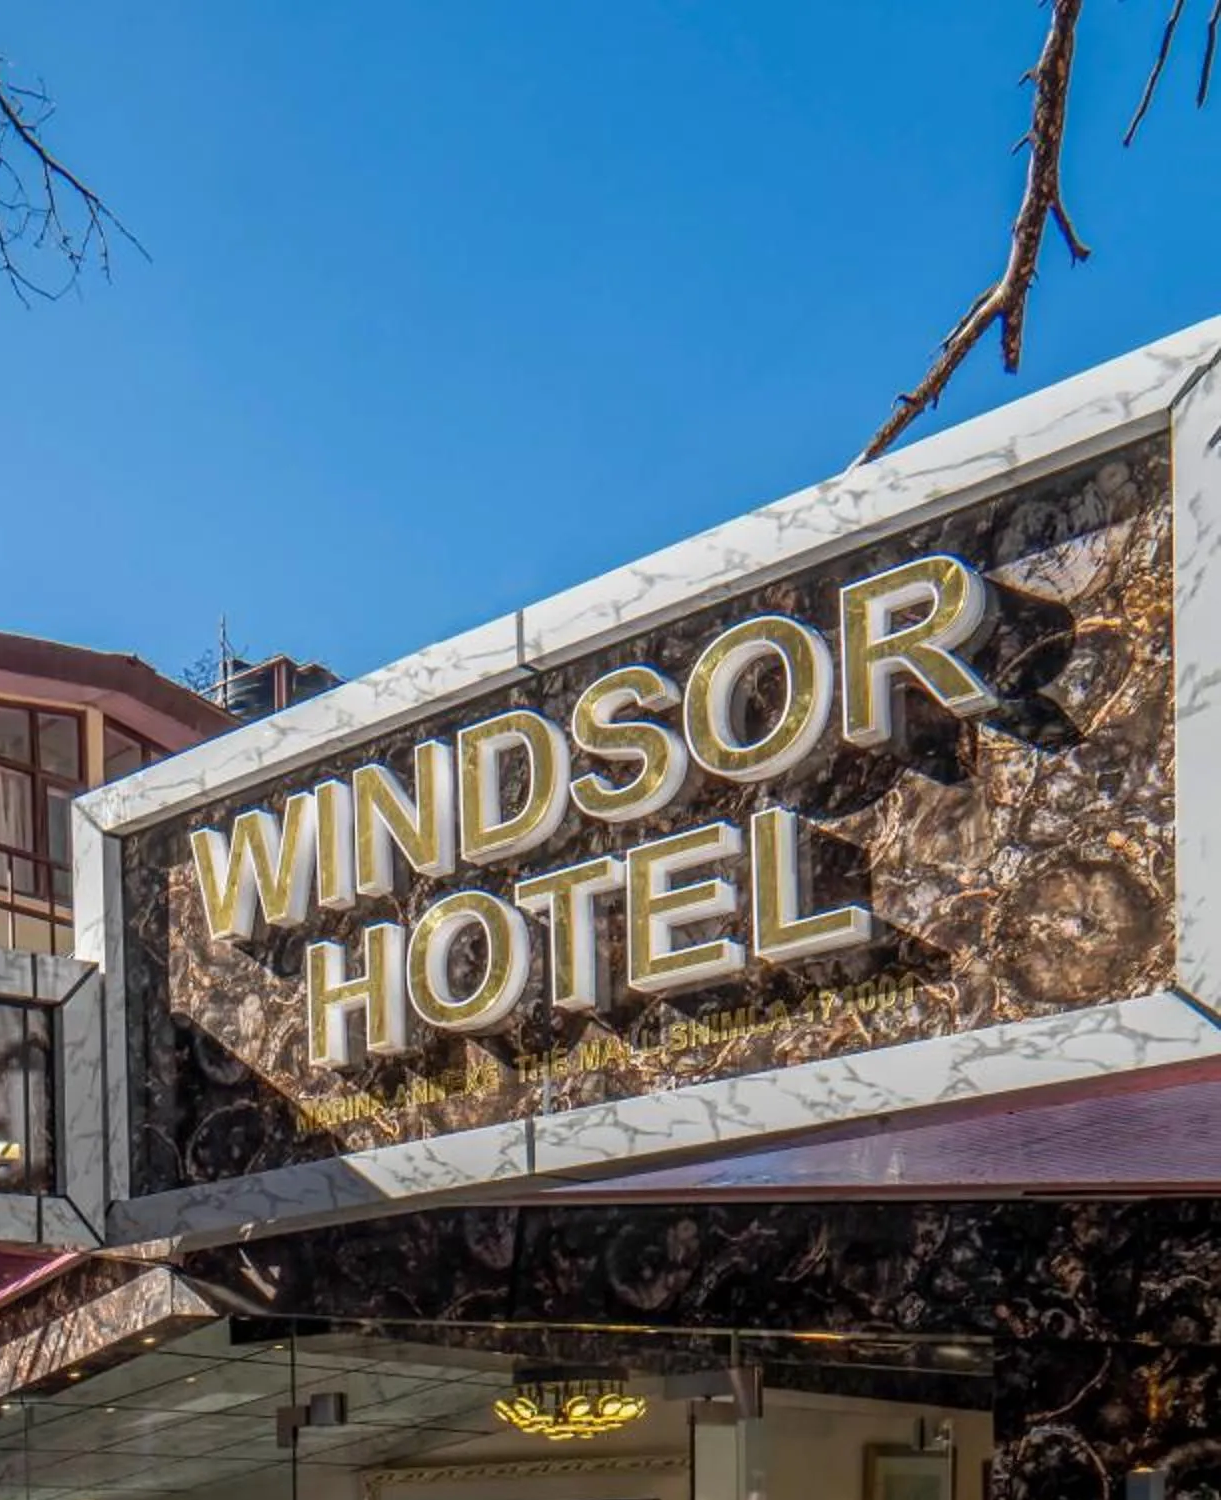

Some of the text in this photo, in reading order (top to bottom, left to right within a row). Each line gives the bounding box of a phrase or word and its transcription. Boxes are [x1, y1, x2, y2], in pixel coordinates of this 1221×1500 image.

[189, 552, 1001, 944] WINDSOR
[306, 806, 872, 1069] HOTEL
[515, 1046, 569, 1083] THE
[668, 998, 792, 1052] SHIMLA
